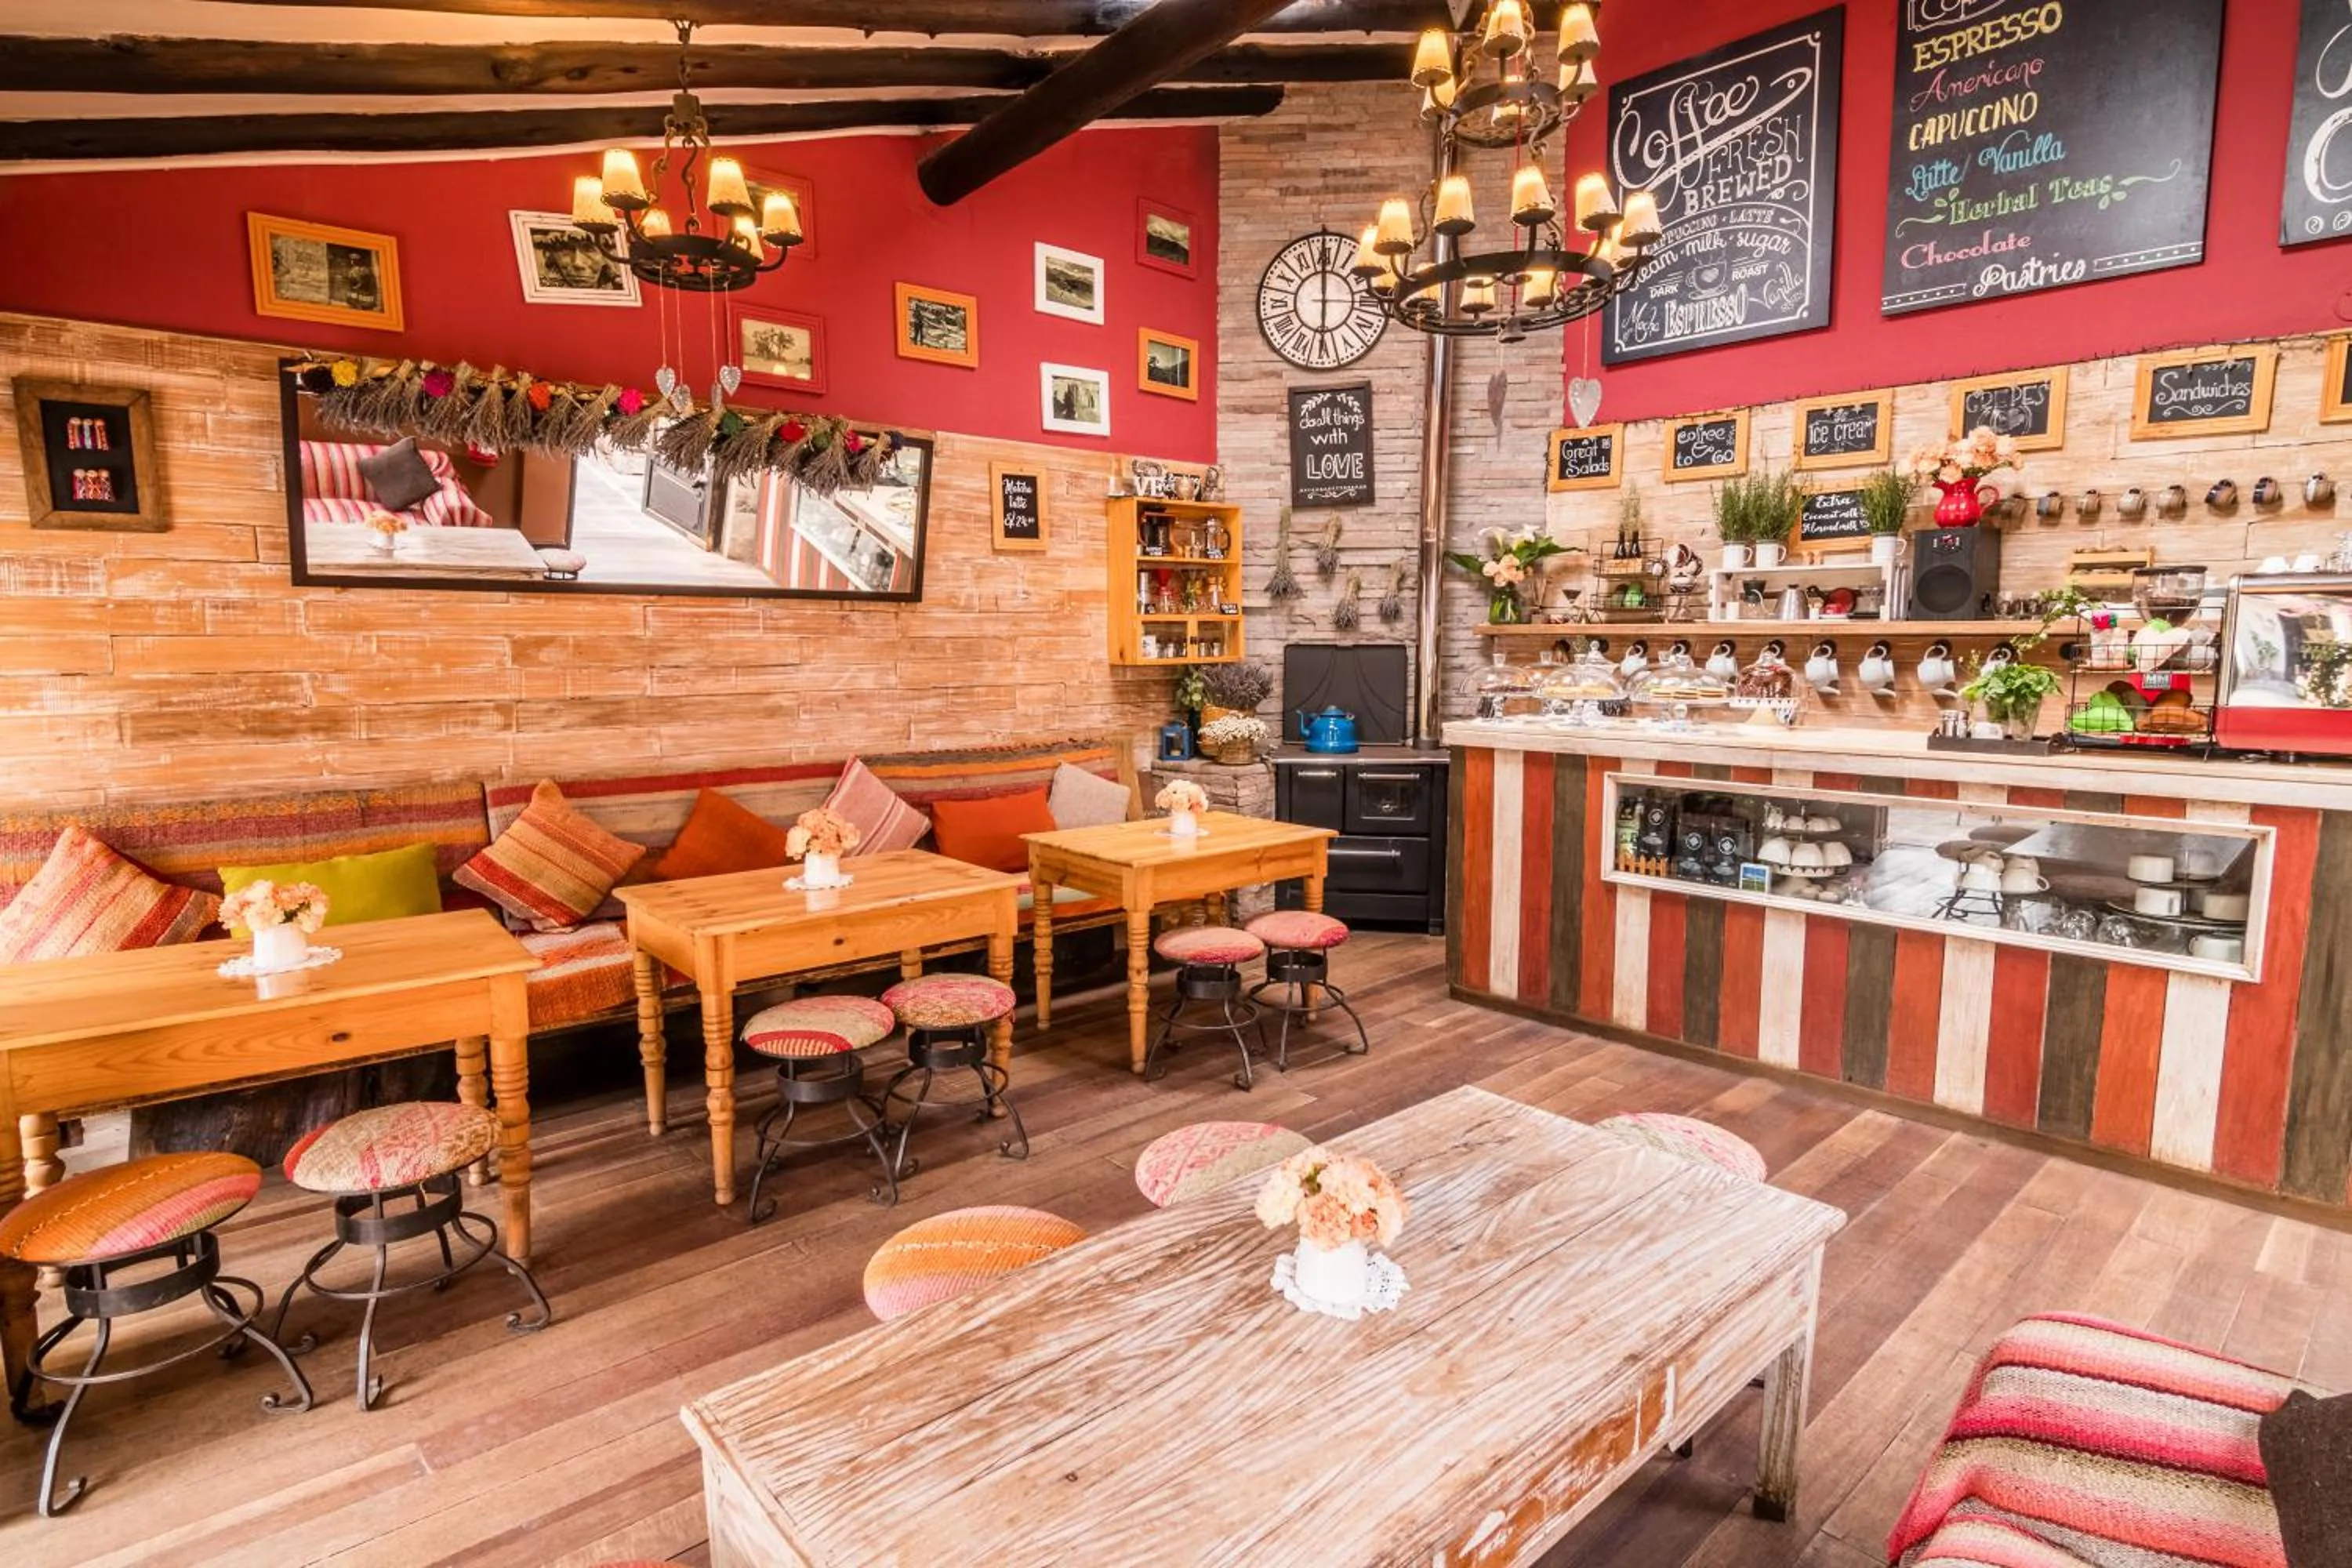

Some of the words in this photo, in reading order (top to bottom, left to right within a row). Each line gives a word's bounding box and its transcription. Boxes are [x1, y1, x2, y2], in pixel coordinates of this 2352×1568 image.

[1912, 2, 2063, 72] ESPRESSO
[1910, 59, 2045, 112] Americano
[1908, 92, 2038, 151] CAPUCCINO
[1613, 75, 1760, 212] Coffee
[1708, 114, 1804, 184] FRESH
[1978, 129, 2066, 175] Vanilla
[1684, 154, 1793, 216] BREWED
[1949, 183, 2039, 226] Herbal
[2049, 174, 2113, 204] Teas
[1686, 230, 1728, 257] milk
[1737, 232, 1791, 258] sugar
[1900, 229, 2032, 270] Chocolate
[1732, 263, 1769, 281] ROAST
[1973, 252, 2087, 297] Pastries
[1649, 283, 1679, 299] DARK
[2155, 371, 2252, 405] Sandwiches
[1310, 427, 1348, 445] with
[1333, 407, 1365, 431] things
[1809, 423, 1829, 445] Ice
[1306, 452, 1364, 480] LOVE
[1562, 439, 1599, 461] Great
[1566, 456, 1610, 477] Salads
[1676, 452, 1693, 467] to
